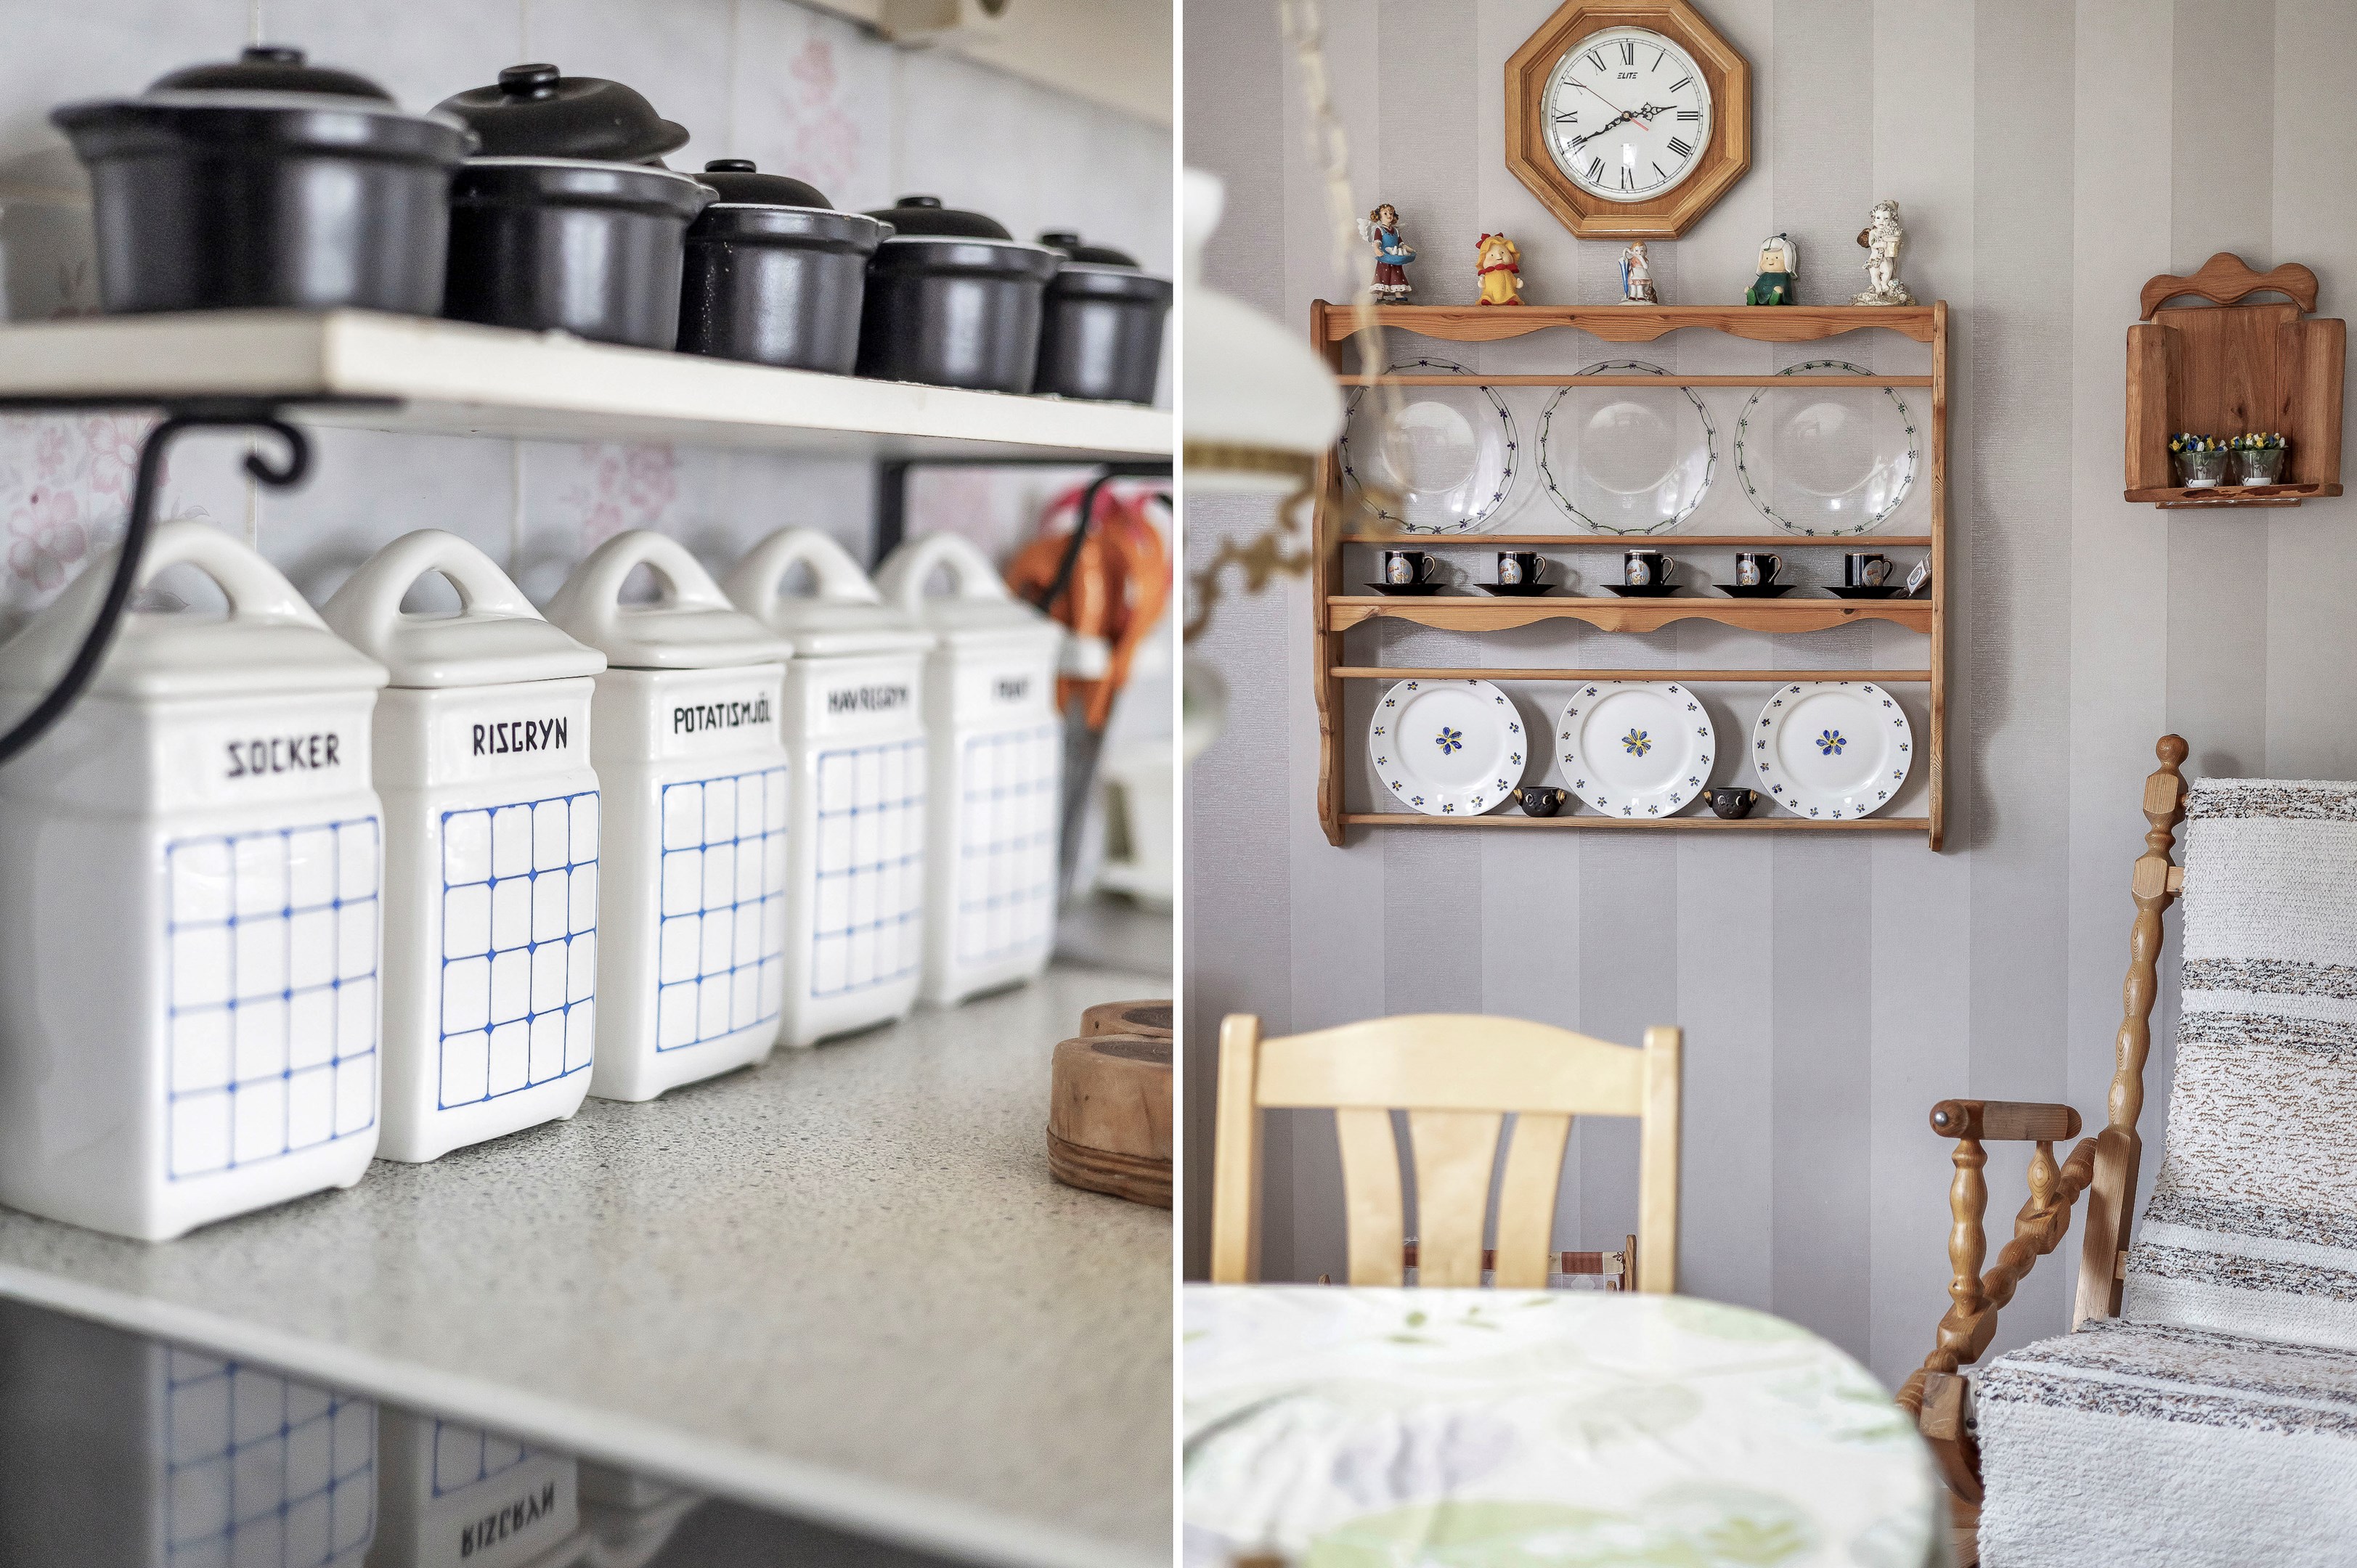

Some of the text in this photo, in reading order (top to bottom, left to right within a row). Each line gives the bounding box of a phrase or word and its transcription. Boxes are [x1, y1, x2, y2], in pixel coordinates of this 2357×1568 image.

[1587, 50, 1606, 75] XI
[1619, 44, 1634, 66] XII
[1669, 77, 1690, 93] II
[1555, 109, 1578, 123] IX
[1677, 111, 1698, 121] III
[1667, 136, 1692, 158] IIII
[473, 716, 567, 756] RISGRYN
[226, 731, 341, 778] SOCKER
